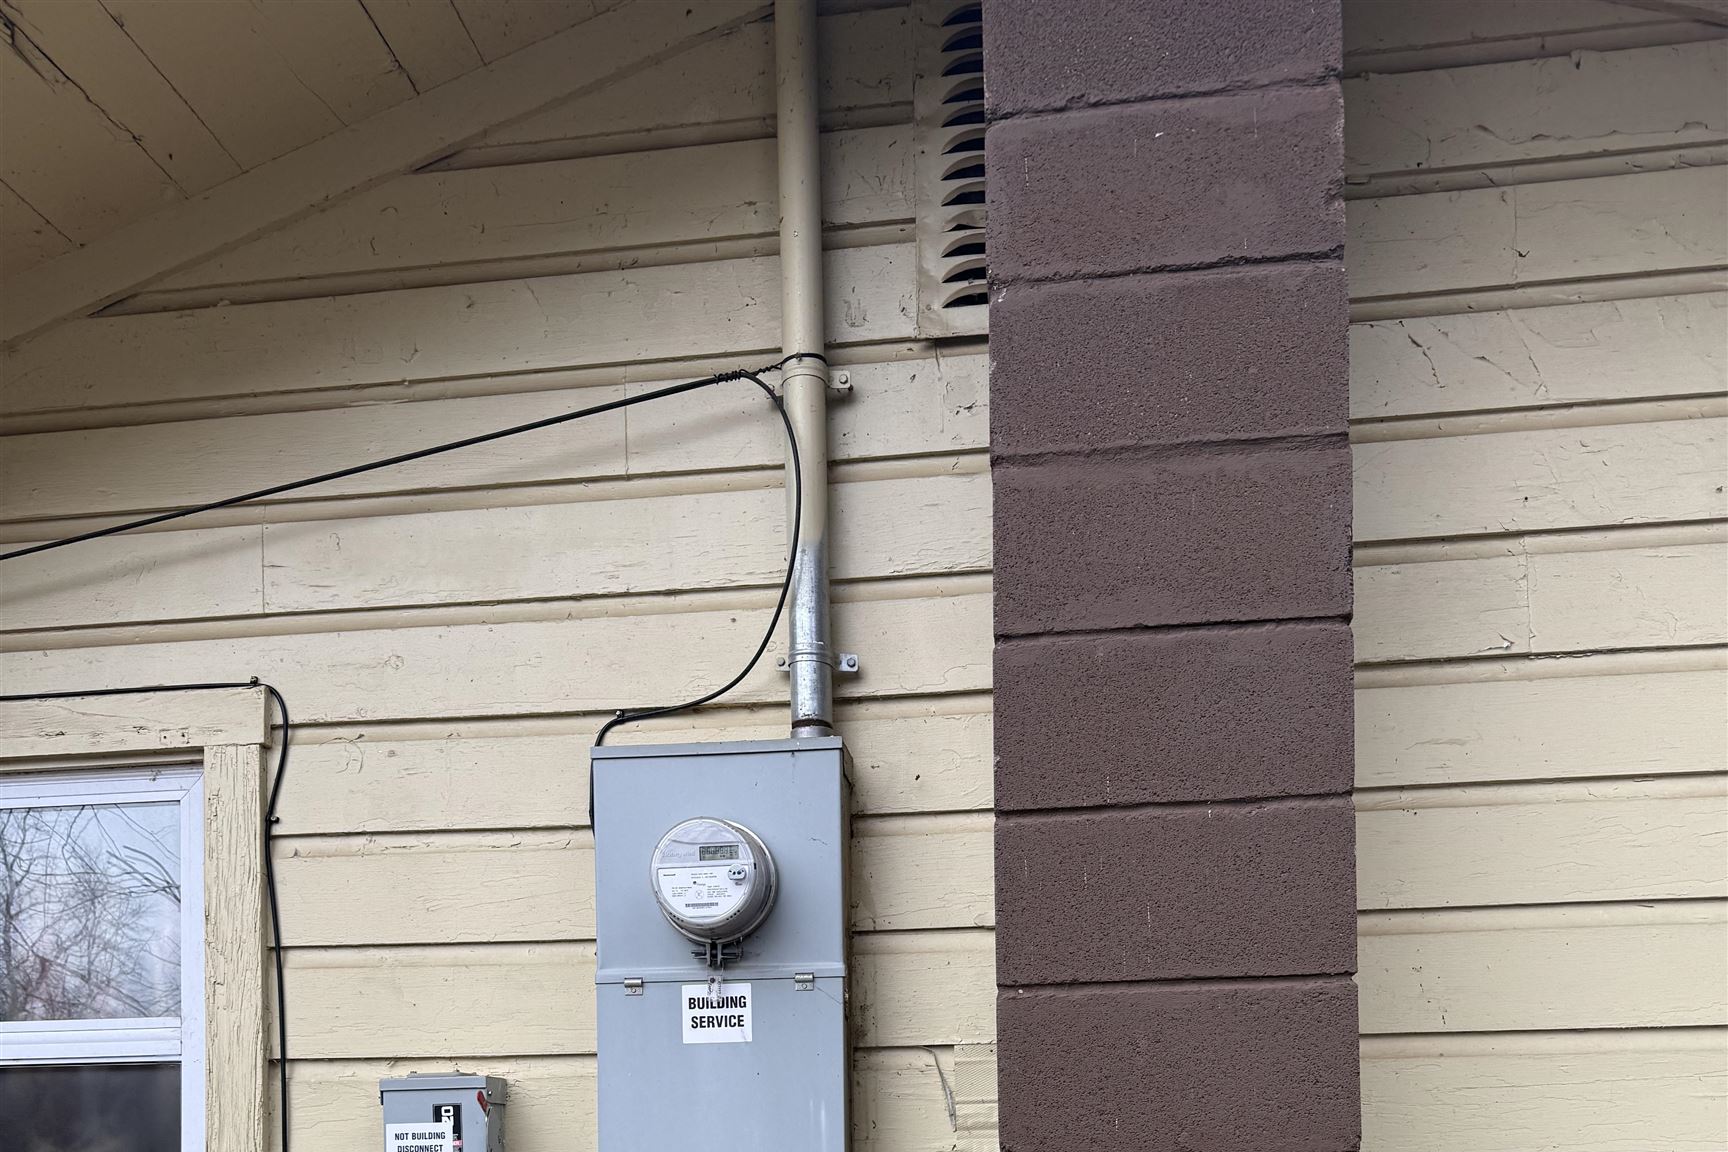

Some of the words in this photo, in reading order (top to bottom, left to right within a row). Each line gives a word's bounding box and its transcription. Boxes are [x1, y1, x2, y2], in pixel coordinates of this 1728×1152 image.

[688, 995, 747, 1010] BUILDING
[690, 1014, 745, 1029] SERVICE
[394, 1132, 410, 1141] NOT
[411, 1131, 446, 1141] BUILDING
[397, 1144, 443, 1152] DISCONNECT
